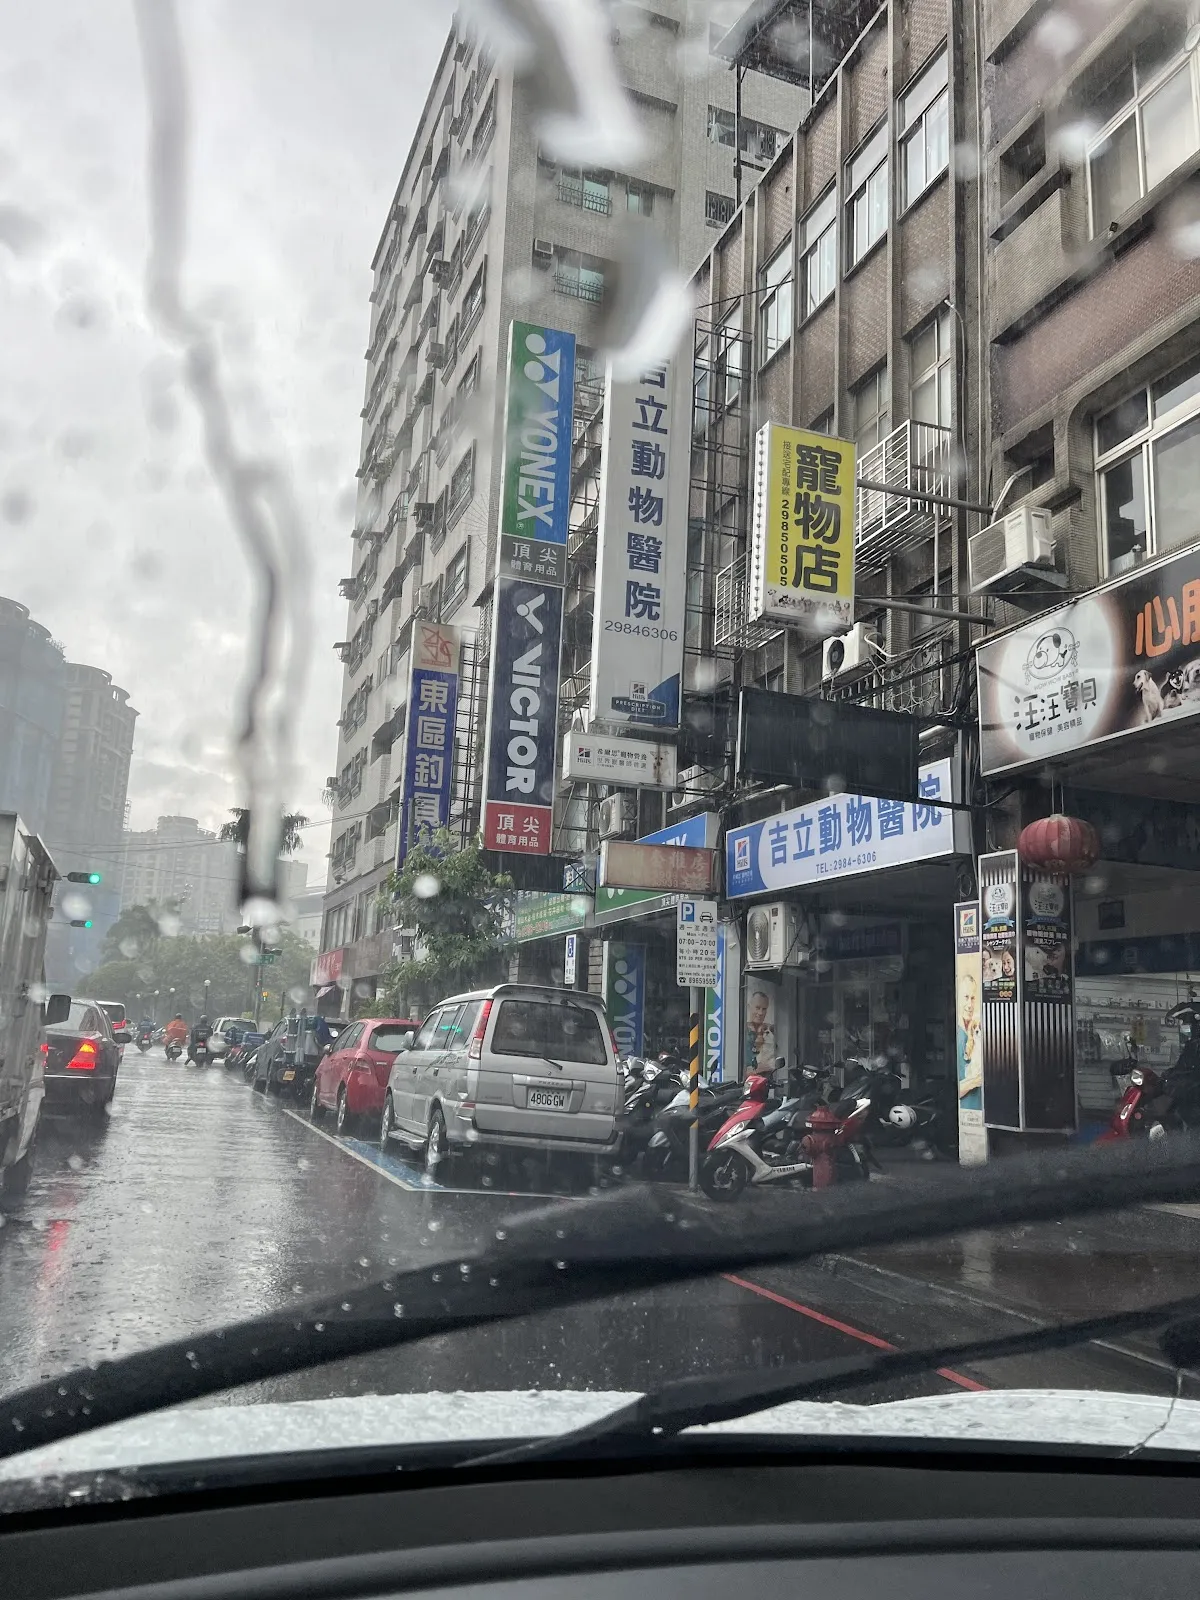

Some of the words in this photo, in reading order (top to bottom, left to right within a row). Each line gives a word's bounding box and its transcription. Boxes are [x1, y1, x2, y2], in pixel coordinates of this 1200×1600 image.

[517, 410, 559, 527] YONEX
[792, 443, 842, 594] 寵物店
[512, 541, 558, 565] 頂尖
[780, 499, 790, 587] 29850505
[510, 559, 557, 577] 體育用品
[604, 620, 679, 642] 29846306
[615, 699, 661, 711] PRESCRIPTION
[1013, 677, 1097, 731] 汪汪寶貝
[505, 642, 543, 794] VICTOR
[496, 813, 540, 834] 頂尖
[768, 773, 942, 868] 吉立動物醫院
[495, 833, 539, 848] 體育用品
[682, 903, 694, 921] P
